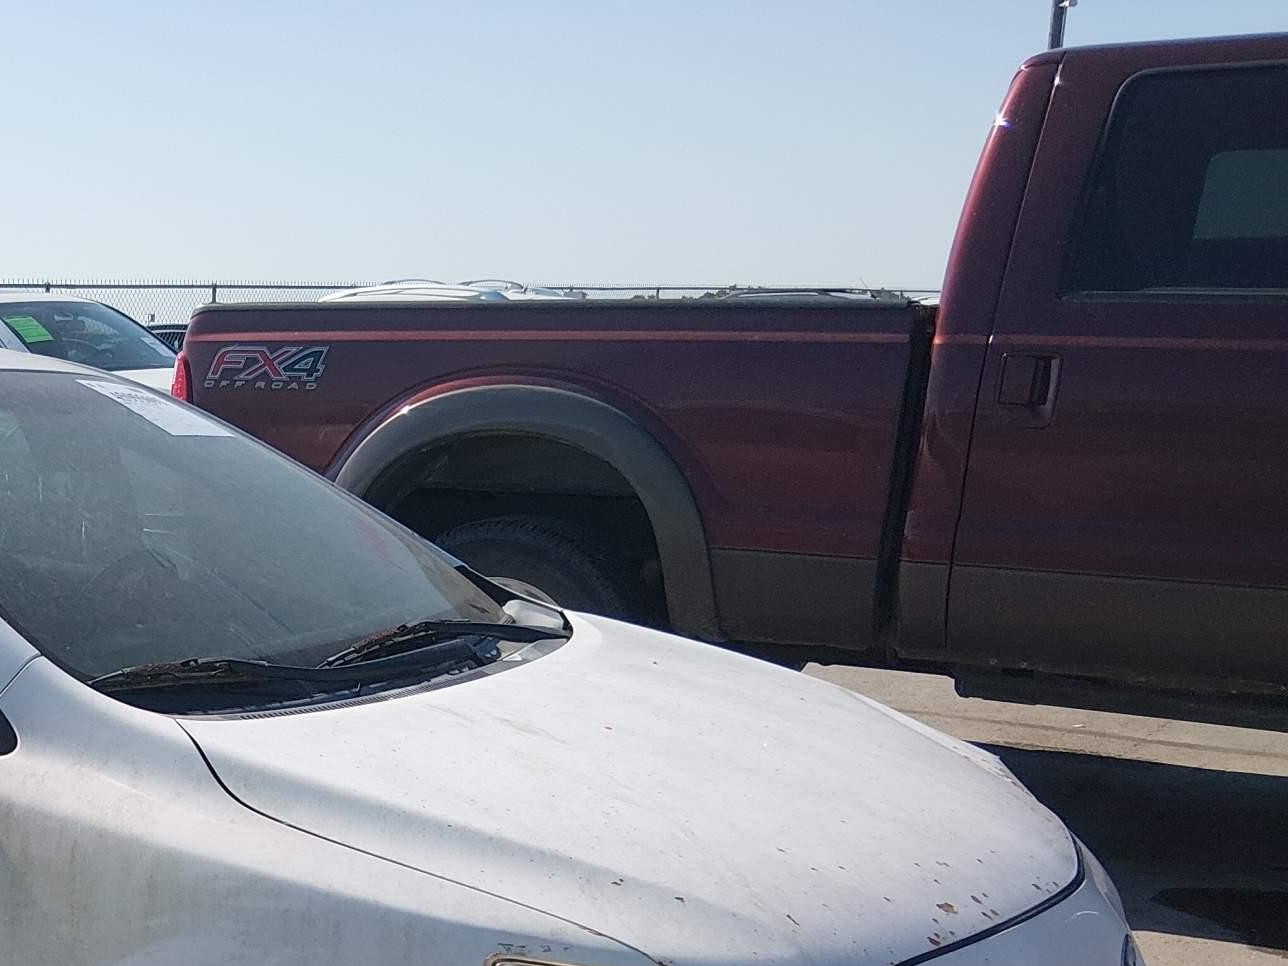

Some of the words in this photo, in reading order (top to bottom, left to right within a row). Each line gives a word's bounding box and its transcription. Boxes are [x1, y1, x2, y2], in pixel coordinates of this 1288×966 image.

[206, 344, 330, 381] FX4
[203, 380, 246, 389] OFF
[255, 381, 318, 390] ROAD
